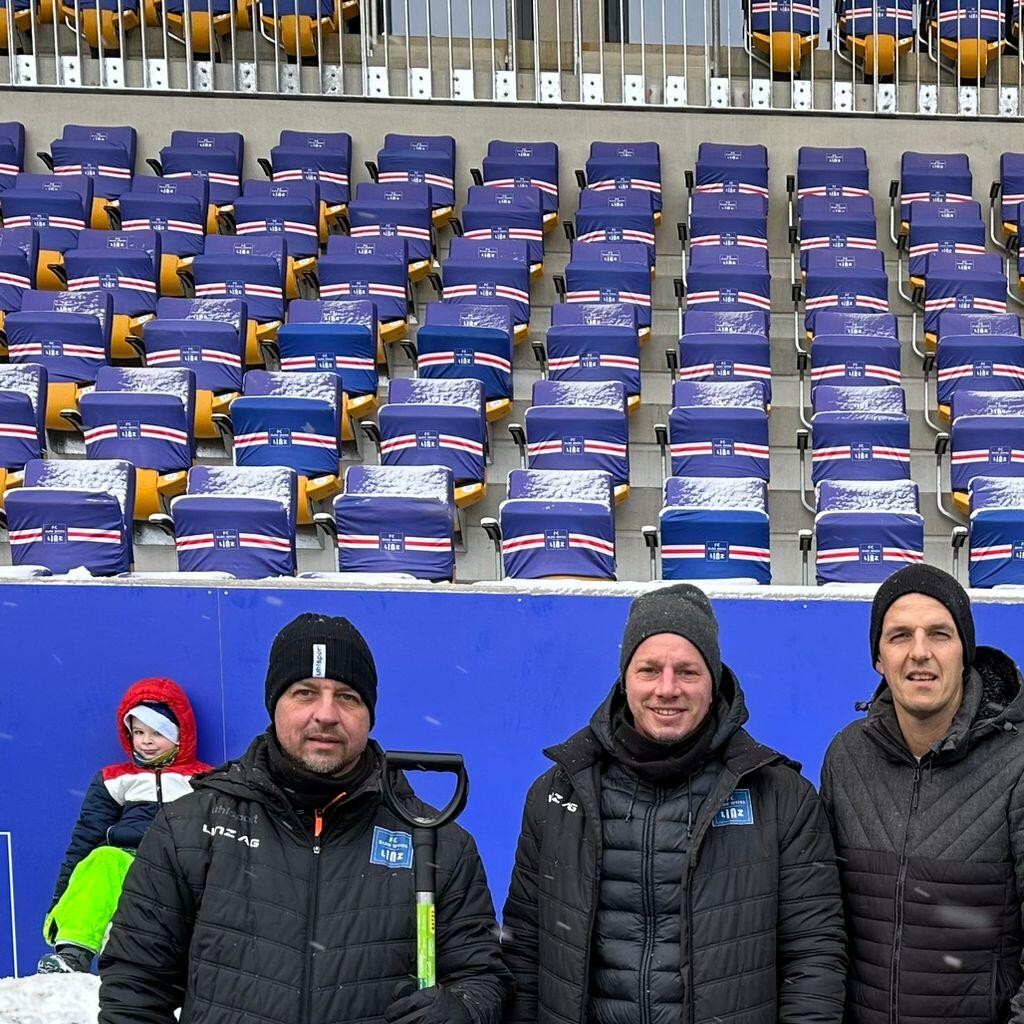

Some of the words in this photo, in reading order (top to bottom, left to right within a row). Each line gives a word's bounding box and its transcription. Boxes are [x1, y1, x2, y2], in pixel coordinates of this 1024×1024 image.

[720, 808, 744, 819] LINZ
[237, 835, 260, 848] AG
[380, 850, 404, 862] LINZ
